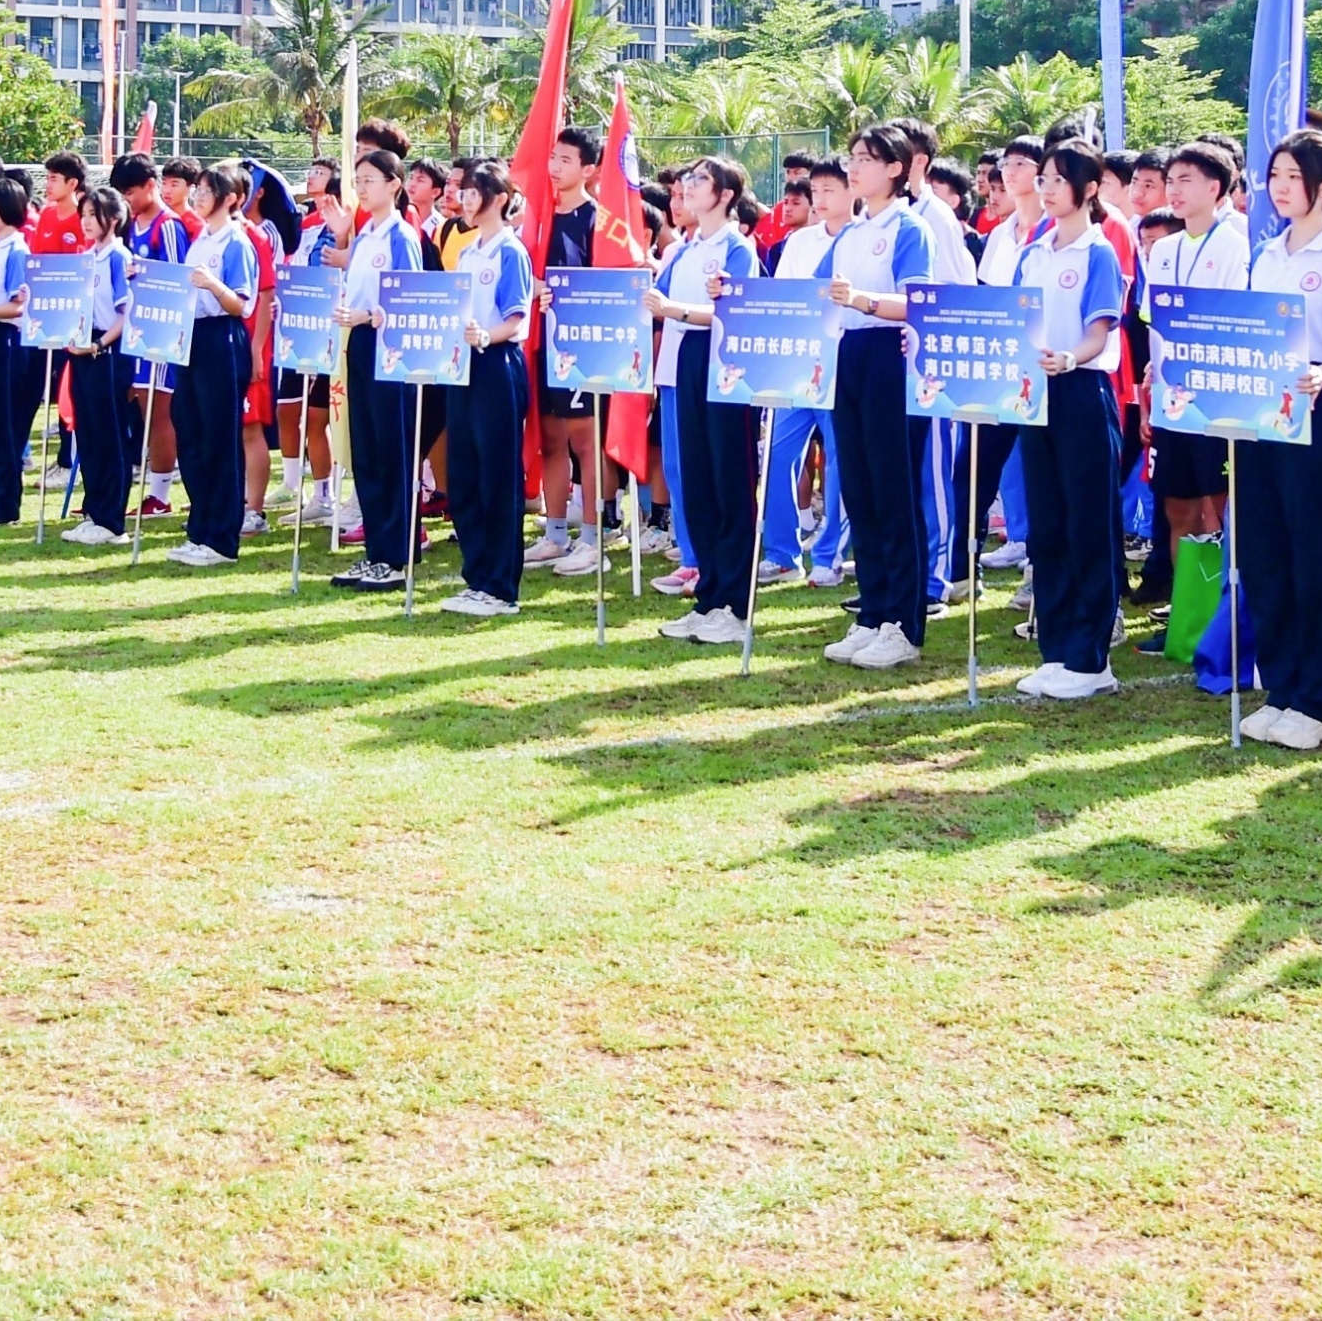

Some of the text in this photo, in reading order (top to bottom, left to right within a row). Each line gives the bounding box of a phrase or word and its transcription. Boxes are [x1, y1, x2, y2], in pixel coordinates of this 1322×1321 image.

[386, 313, 460, 331] 海口市第九中学
[401, 333, 444, 351] 海甸学校
[558, 324, 638, 344] 海口市第二中学
[924, 333, 1019, 357] 北京师范大学
[725, 335, 822, 357] 海口市长彤学校
[1163, 340, 1300, 372] 海口市滨海第九小学
[924, 358, 1020, 381] 海口附属学校
